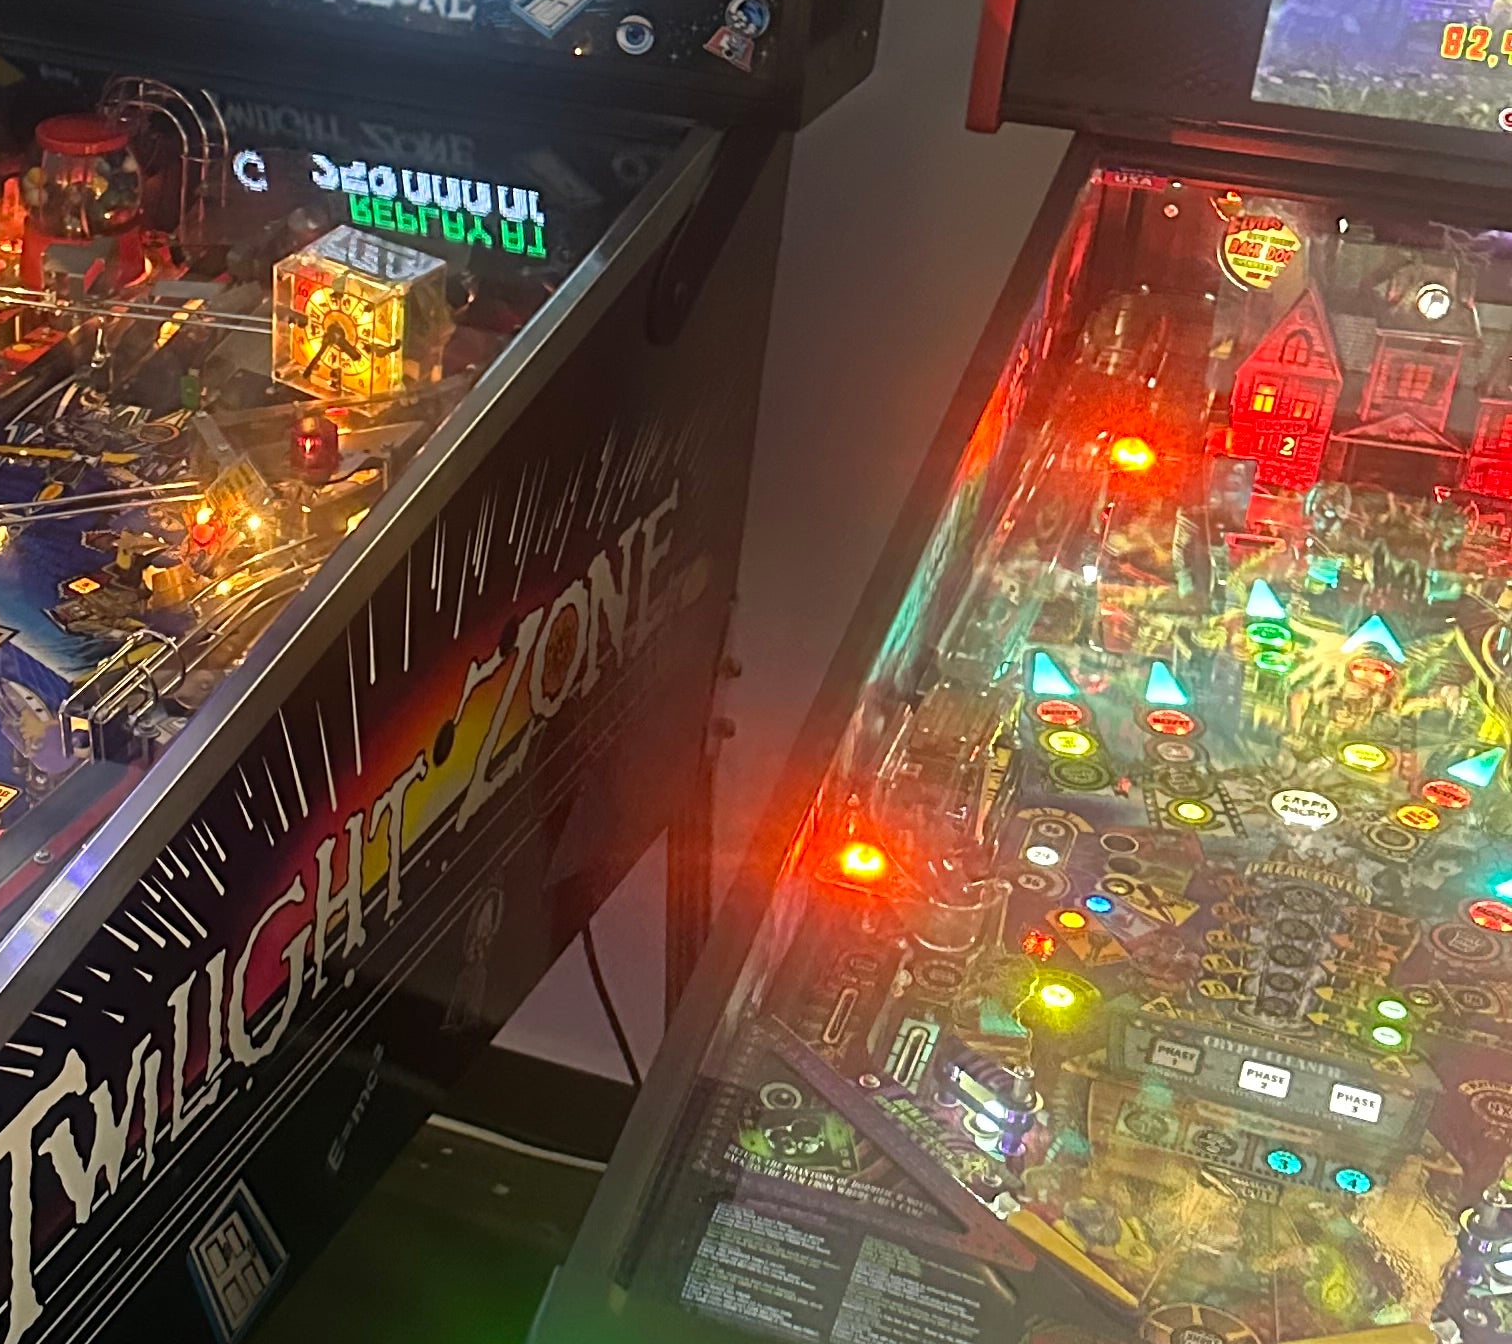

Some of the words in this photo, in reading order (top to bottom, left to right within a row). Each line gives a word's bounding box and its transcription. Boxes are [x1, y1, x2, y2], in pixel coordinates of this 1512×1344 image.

[1228, 237, 1261, 257] BACK
[1267, 242, 1295, 265] DOO
[433, 478, 681, 832] ZONE
[1246, 1067, 1285, 1085] PHASE
[1336, 1091, 1376, 1109] PHASE
